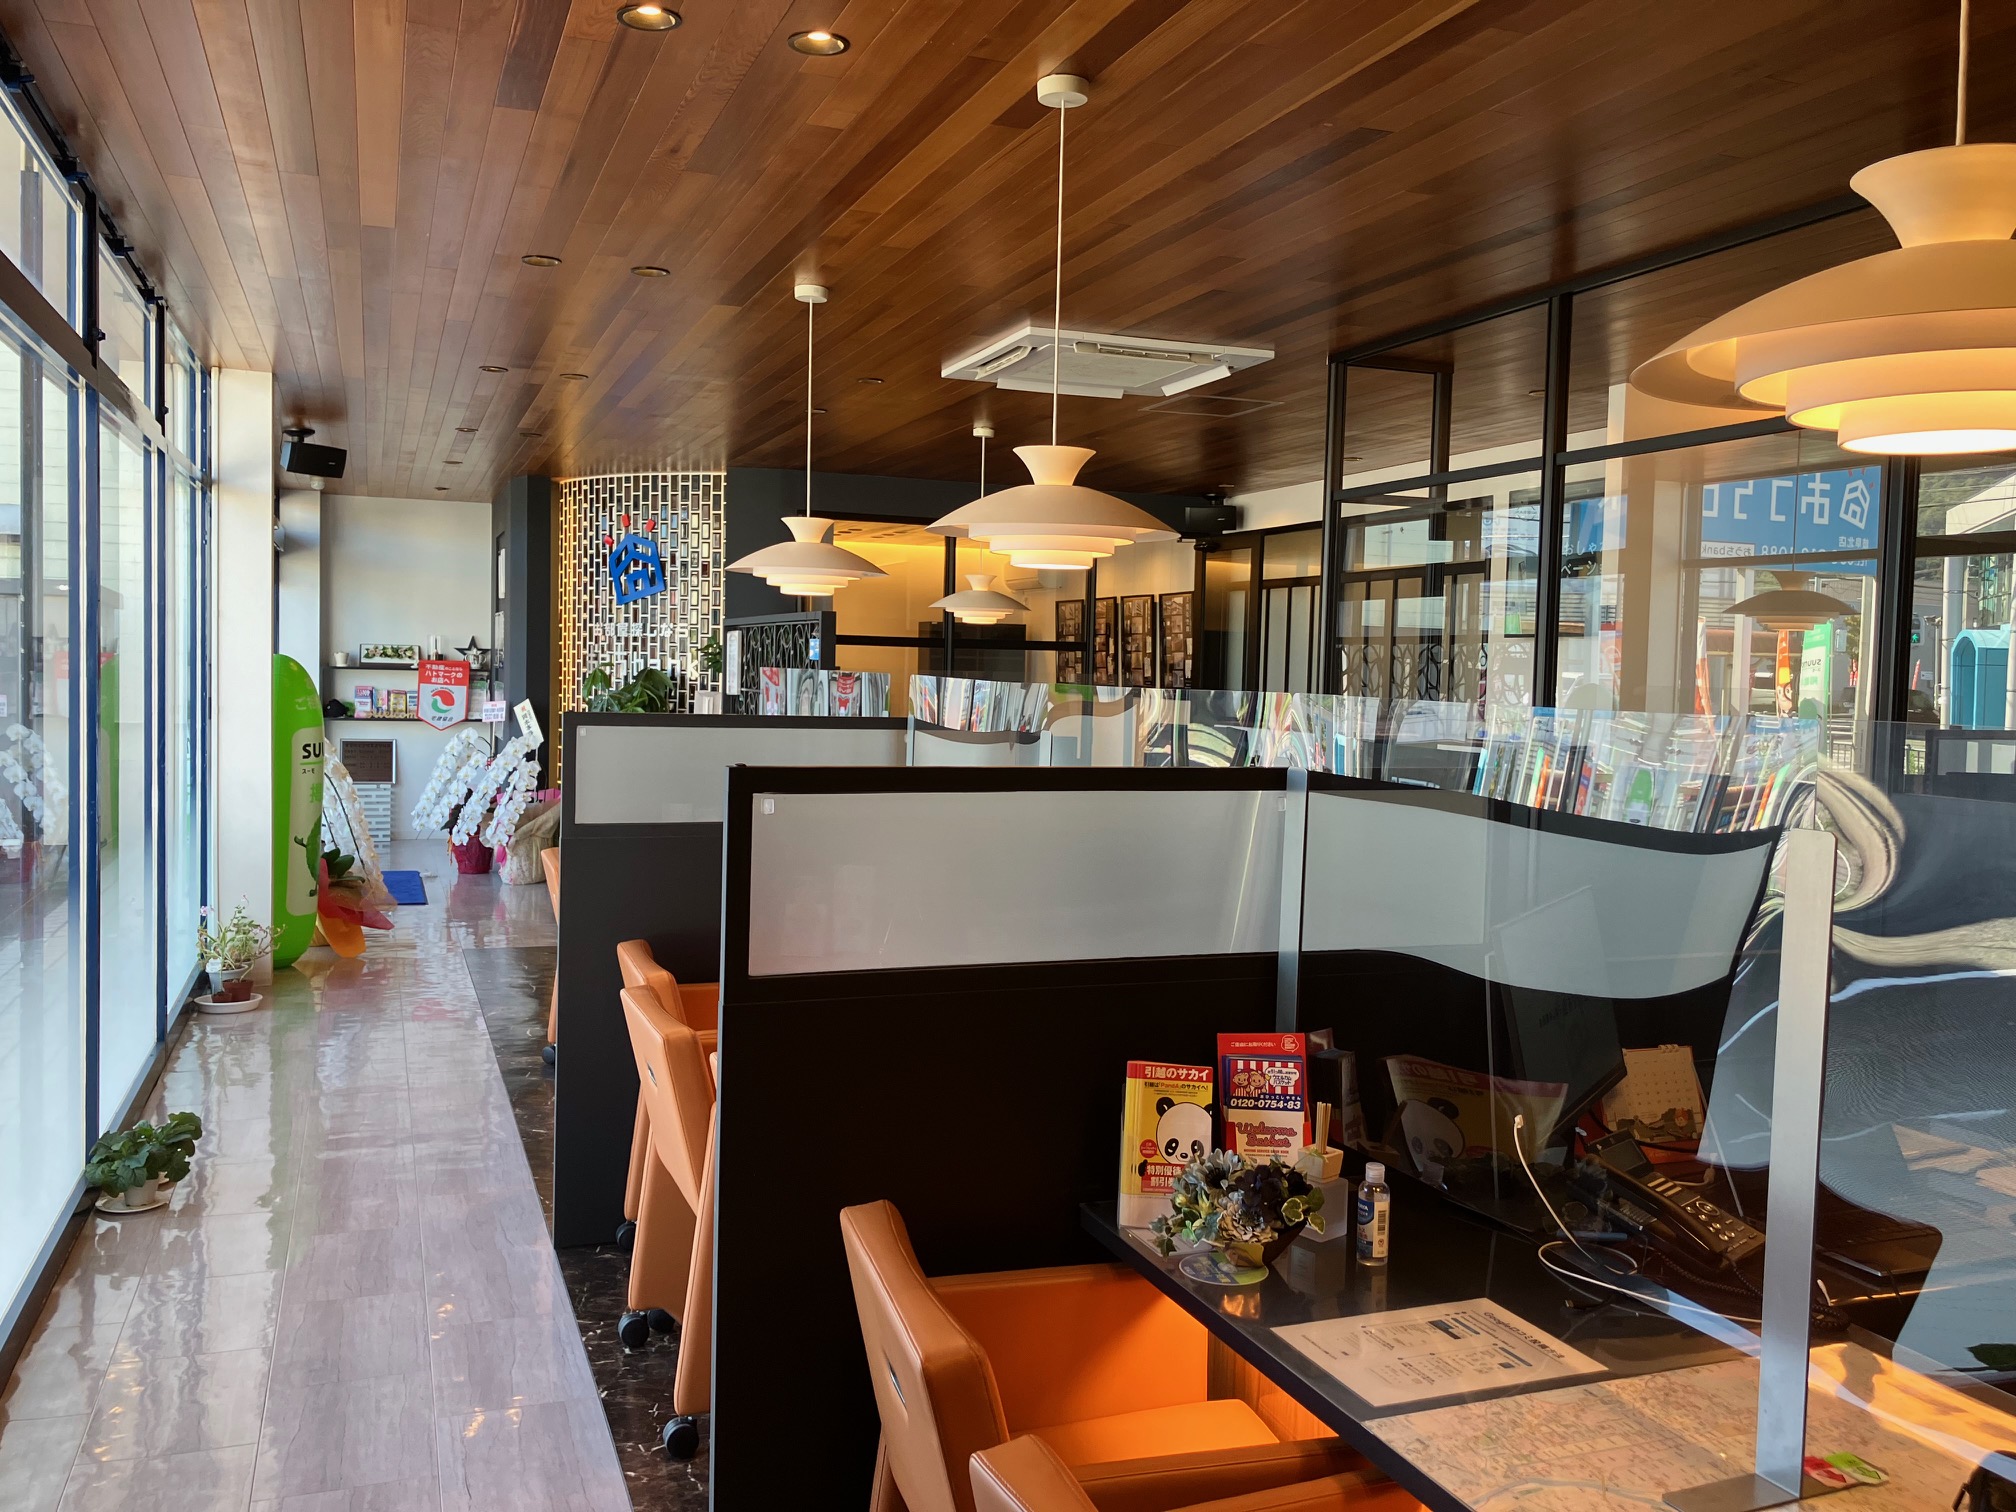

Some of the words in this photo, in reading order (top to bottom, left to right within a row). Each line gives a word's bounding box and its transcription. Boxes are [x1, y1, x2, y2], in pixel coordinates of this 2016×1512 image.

[1144, 1066, 1209, 1081] 引越のサカイ
[1230, 1098, 1301, 1109] 0120-0754-83
